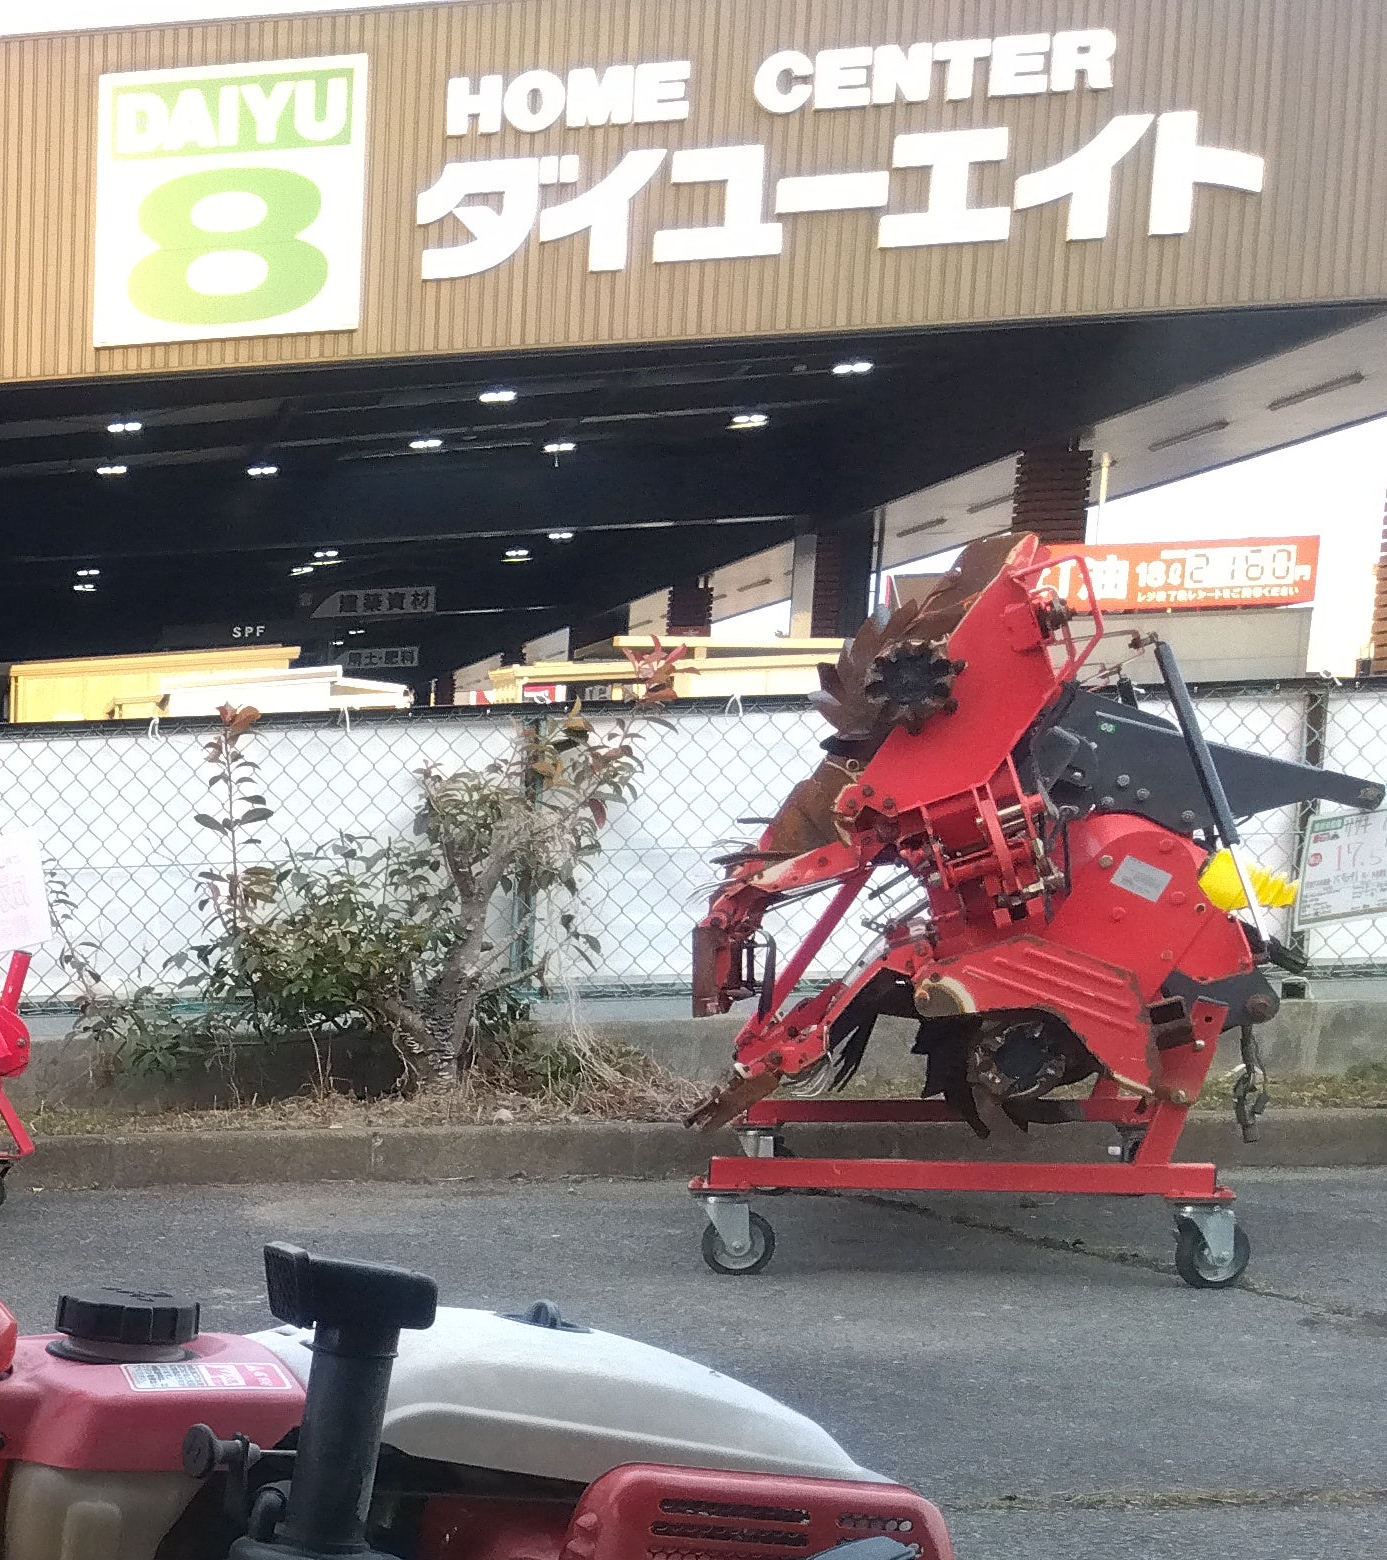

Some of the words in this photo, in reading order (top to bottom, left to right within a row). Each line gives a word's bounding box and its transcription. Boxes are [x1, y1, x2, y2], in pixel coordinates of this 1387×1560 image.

[114, 76, 349, 155] DAIYU
[447, 61, 691, 137] HOME
[753, 29, 1117, 115] CENTER
[127, 165, 329, 324] 8
[417, 109, 1265, 281] ダイユーエイト
[231, 625, 267, 639] SPF
